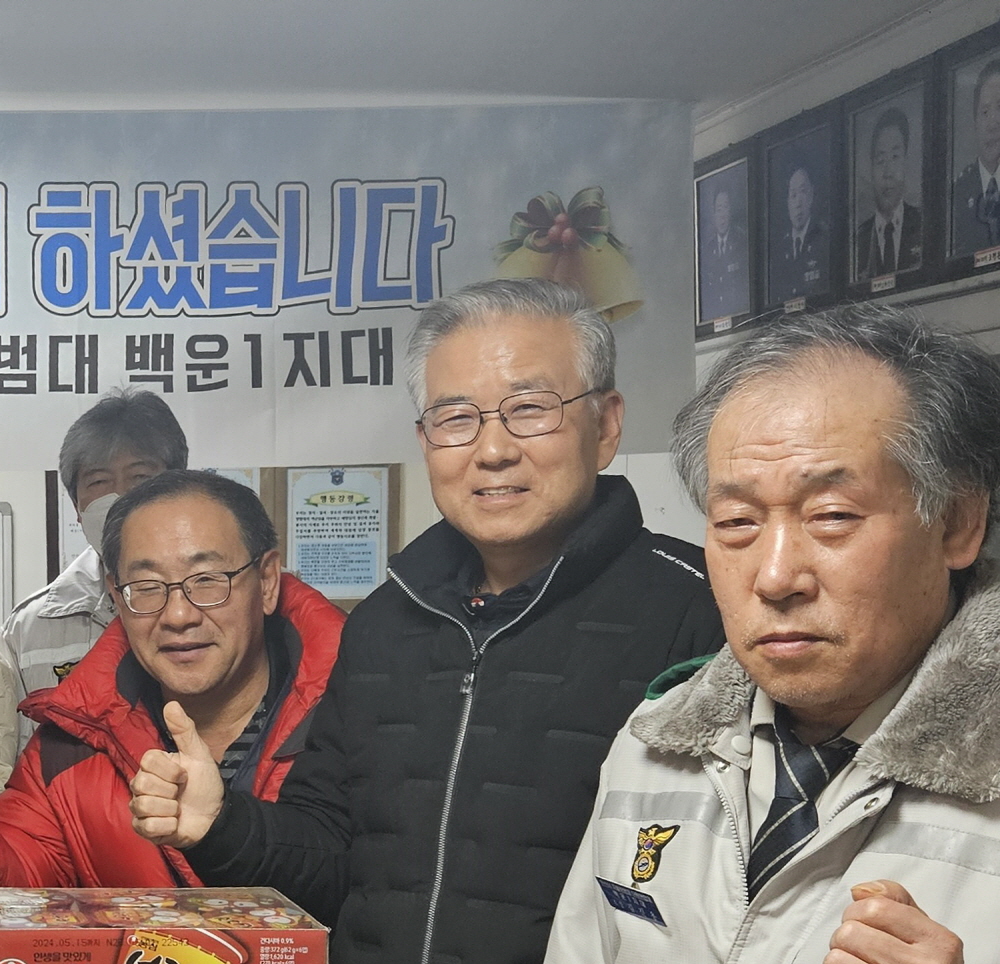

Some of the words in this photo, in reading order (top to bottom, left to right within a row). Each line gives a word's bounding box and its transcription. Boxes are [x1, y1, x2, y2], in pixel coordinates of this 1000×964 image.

[28, 177, 455, 318] 하셨습니다
[125, 326, 394, 394] 백운1지대
[33, 952, 61, 962] 인생을
[62, 951, 92, 962] 맛있게
